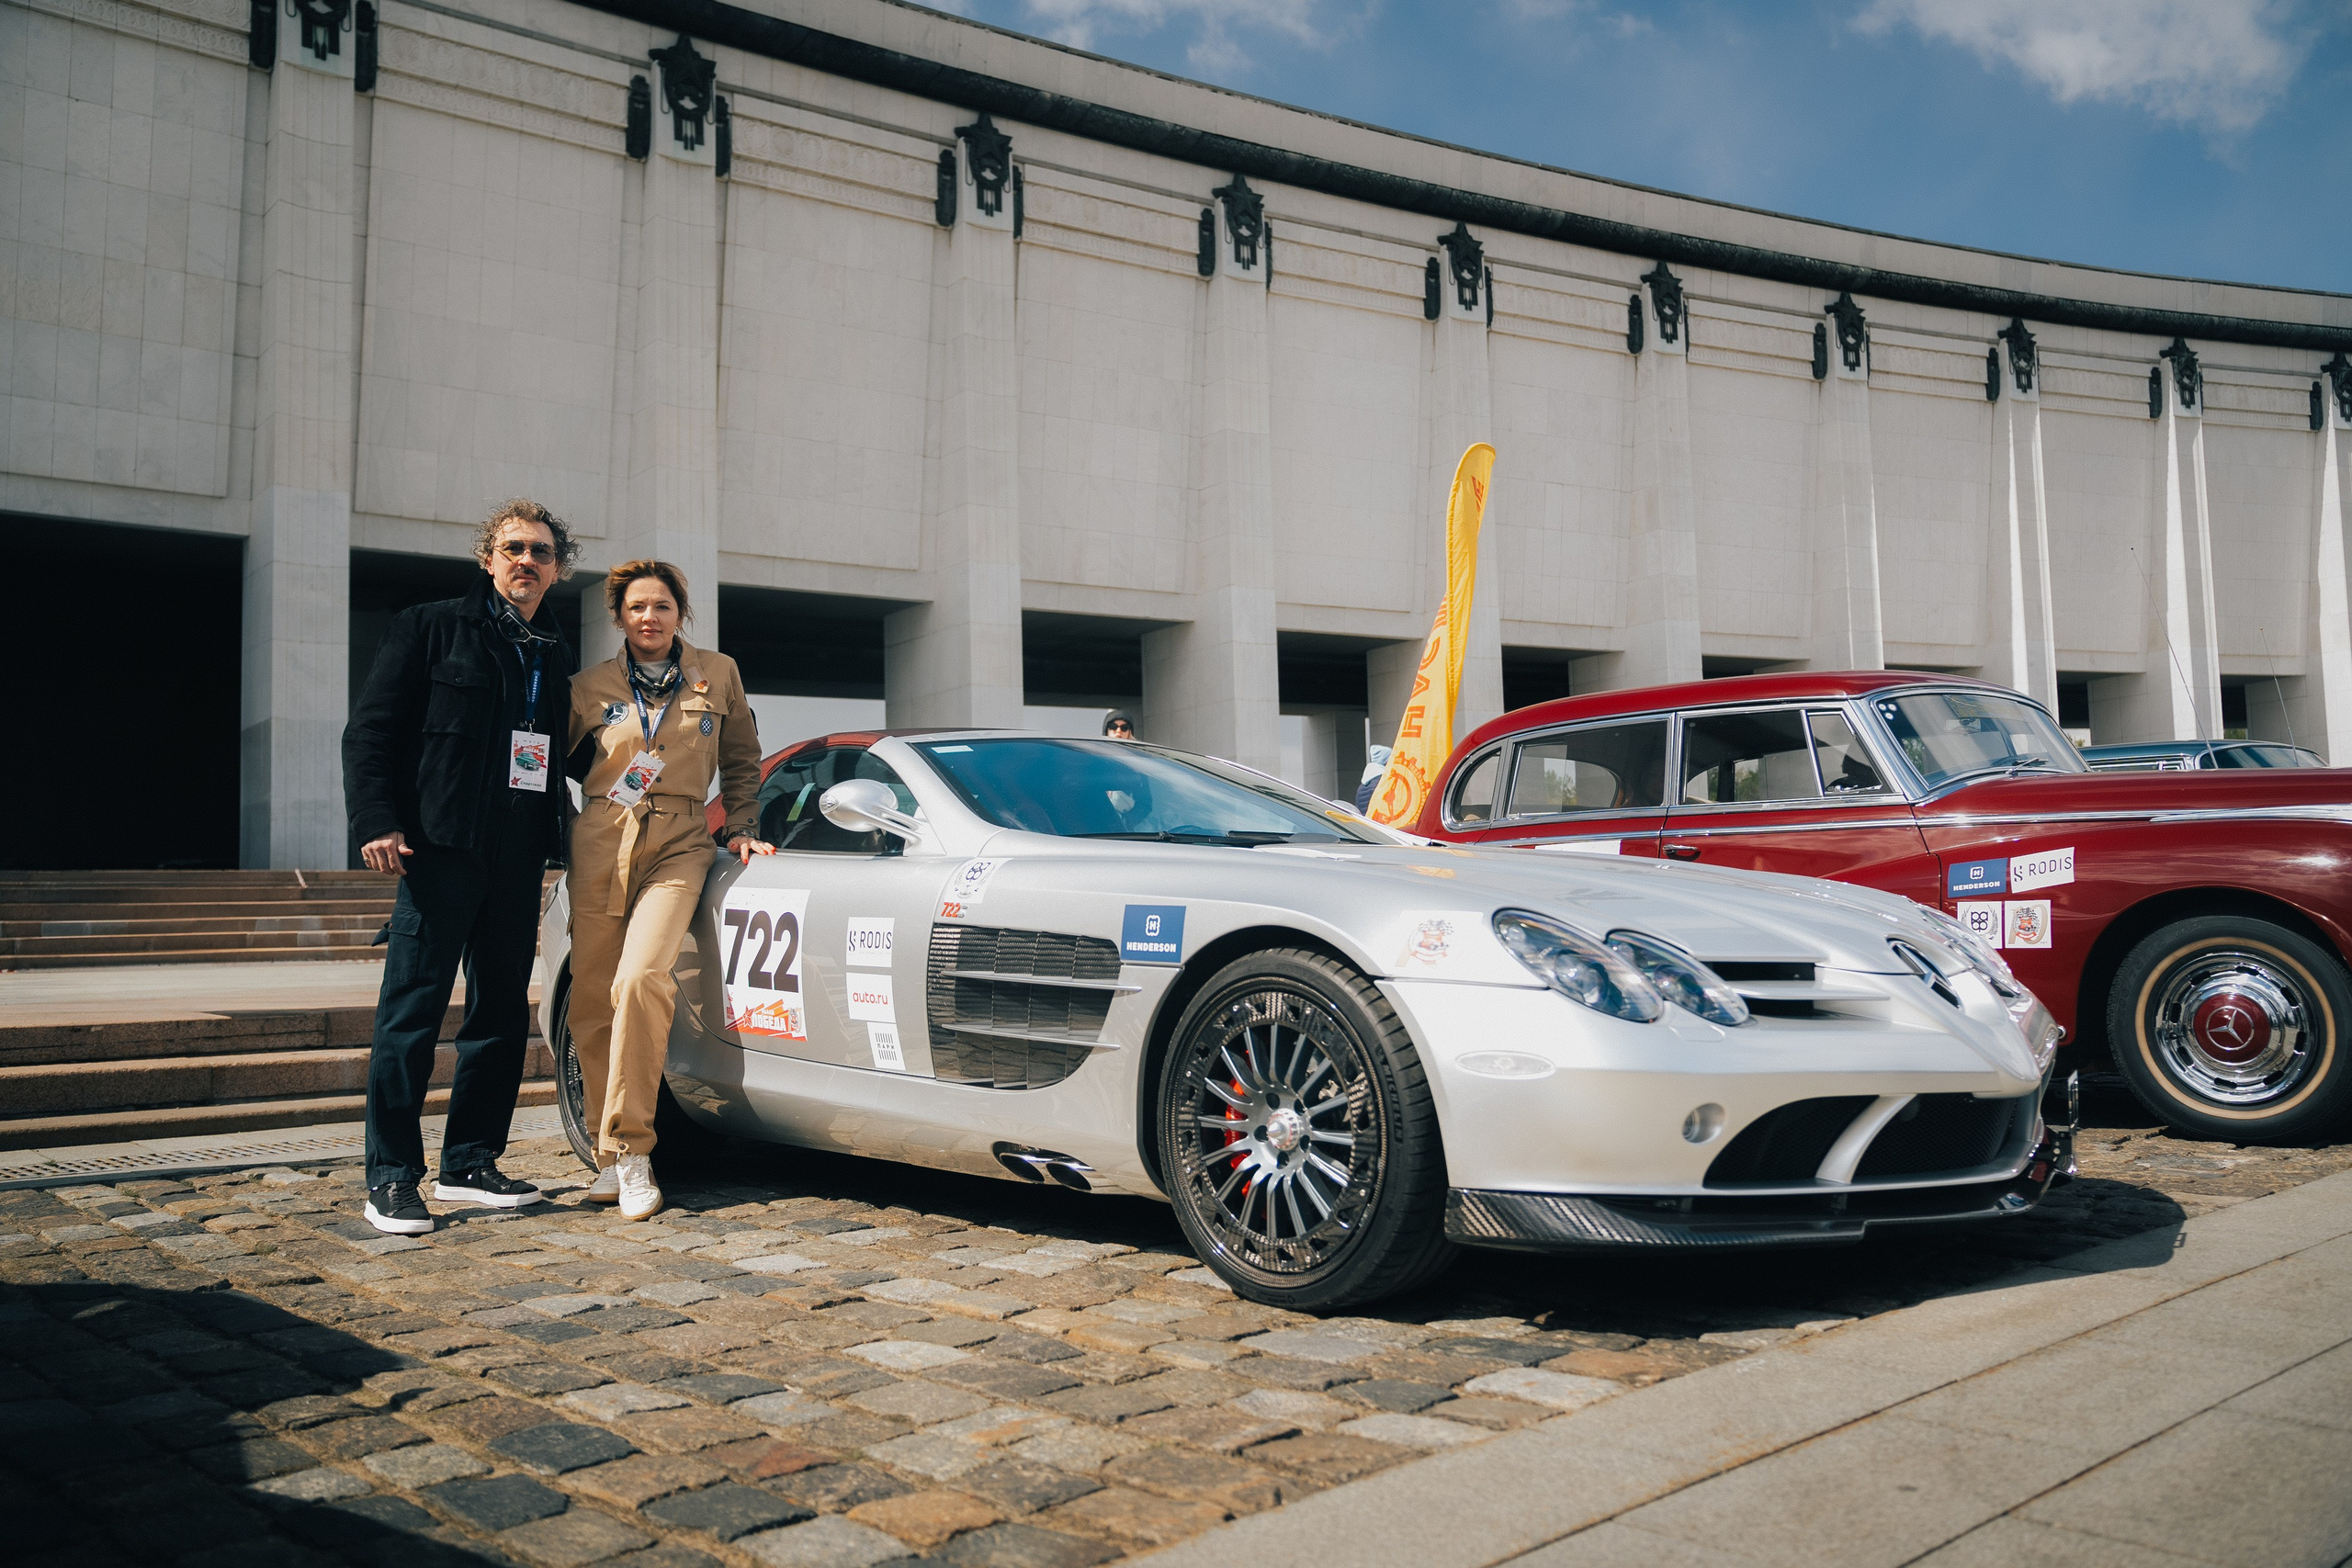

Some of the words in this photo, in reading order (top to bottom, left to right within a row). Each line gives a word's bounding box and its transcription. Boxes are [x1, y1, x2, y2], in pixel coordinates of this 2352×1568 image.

[2029, 856, 2073, 876] RODIS
[1952, 881, 2001, 892] HENDERSON
[860, 931, 892, 950] RODIS
[1126, 942, 1177, 953] HENDERSON
[724, 908, 799, 993] 722
[853, 991, 888, 1005] auto.ru
[752, 1013, 787, 1032] ПОБЕДА
[1383, 1064, 1404, 1140] MICHELIN
